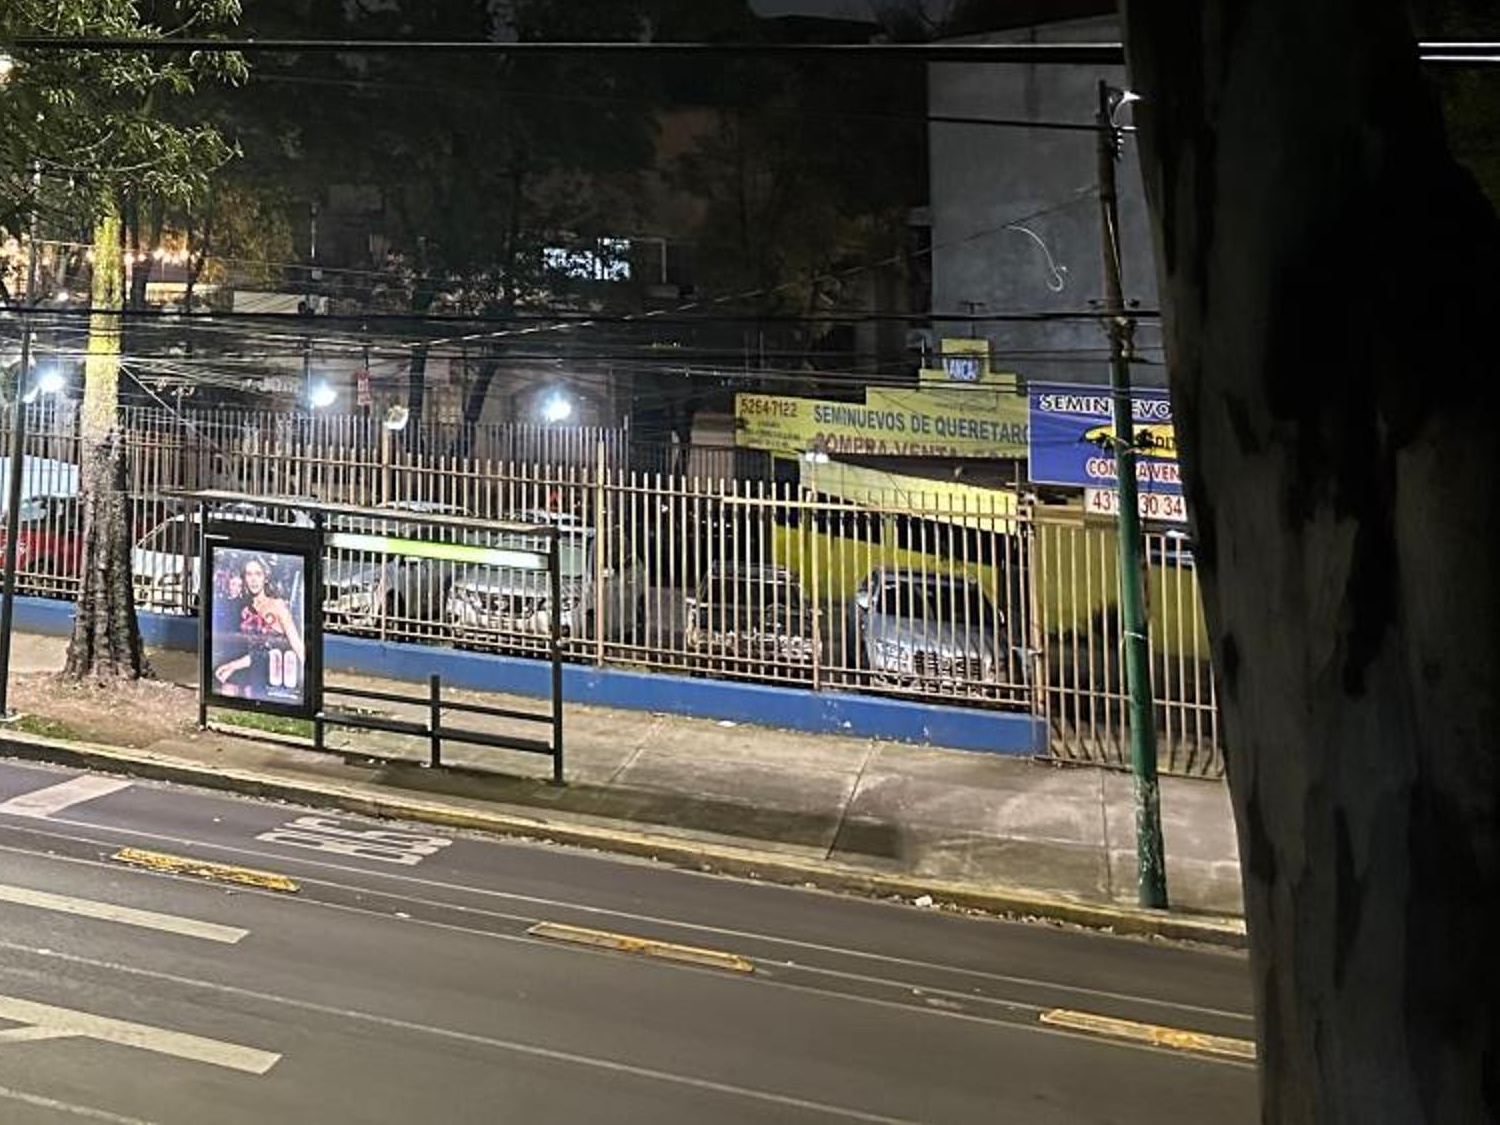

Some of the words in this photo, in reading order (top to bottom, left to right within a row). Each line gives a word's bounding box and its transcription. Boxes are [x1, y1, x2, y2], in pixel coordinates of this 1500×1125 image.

[813, 404, 905, 432] SEMINUEVOS
[911, 414, 931, 434] DE
[1163, 497, 1183, 517] 34
